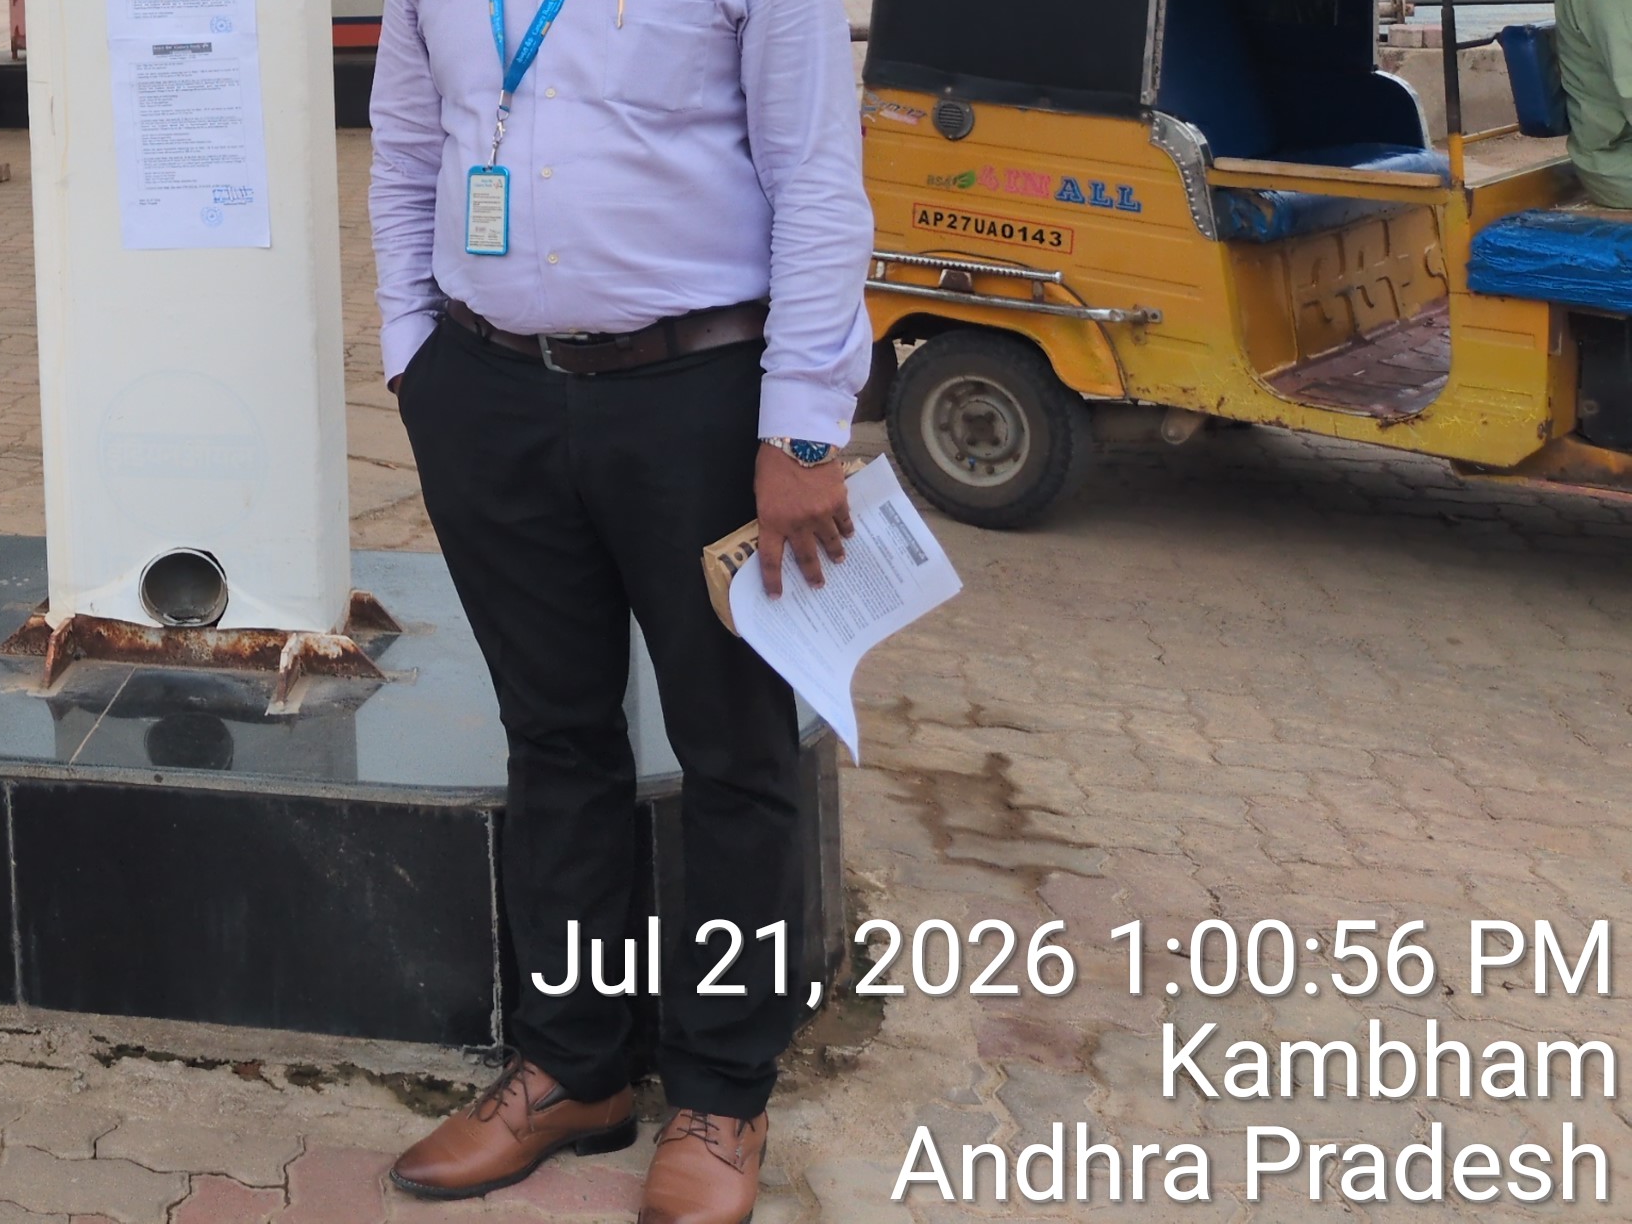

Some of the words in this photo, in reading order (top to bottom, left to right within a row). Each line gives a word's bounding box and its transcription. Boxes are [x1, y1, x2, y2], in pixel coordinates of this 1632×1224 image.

[1004, 168, 1052, 199] IN
[1055, 176, 1141, 213] ALL
[917, 209, 1063, 248] AP27UA0143
